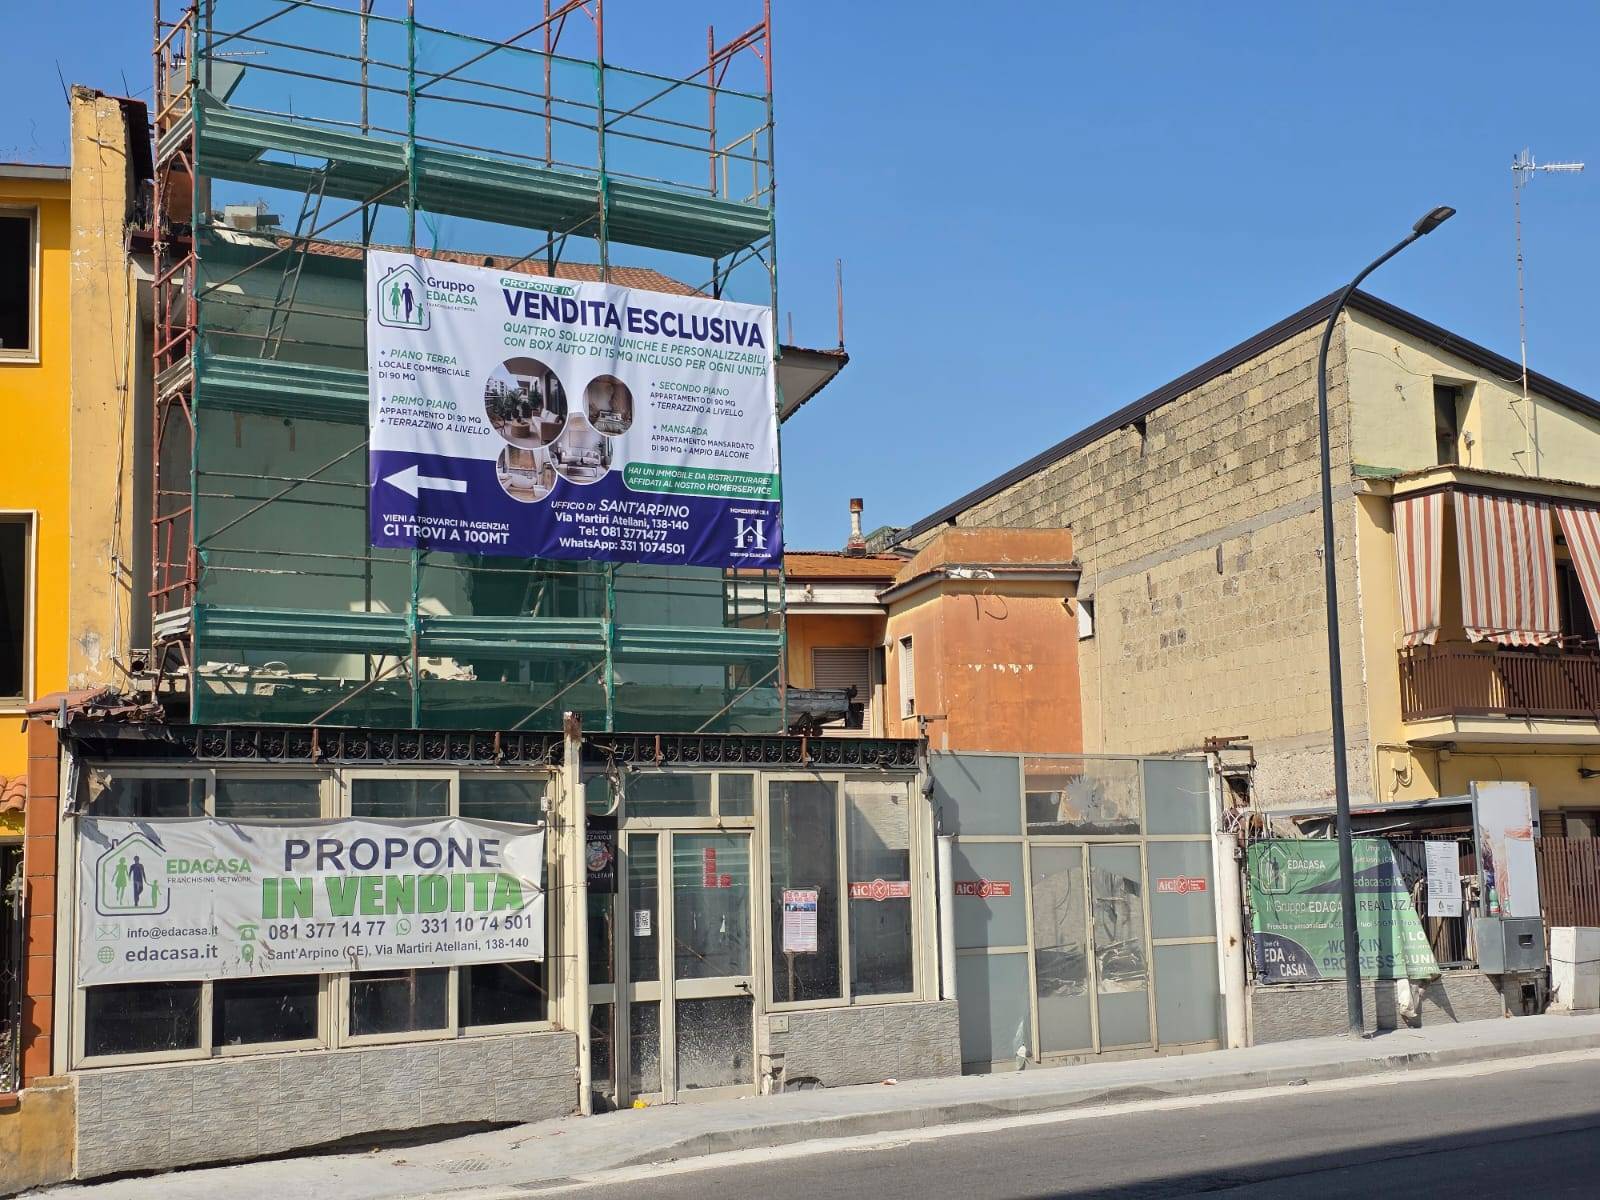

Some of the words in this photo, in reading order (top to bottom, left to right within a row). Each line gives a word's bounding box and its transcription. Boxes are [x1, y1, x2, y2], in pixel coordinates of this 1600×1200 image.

[427, 277, 475, 293] Gruppo
[502, 279, 559, 293] PROPONE
[560, 287, 573, 296] IN
[427, 291, 478, 306] EDACASA
[503, 289, 622, 330] VENDITA
[627, 306, 765, 348] ESCLUSIVA
[503, 322, 555, 338] QUATTRO
[559, 330, 617, 345] SOLUZIONI
[619, 338, 657, 352] UNICHE
[661, 344, 667, 353] E
[671, 345, 765, 364] PERSONALIZZABILI
[390, 349, 422, 361] PIANO
[427, 353, 457, 365] TERRA
[504, 336, 525, 348] CON
[530, 339, 552, 351] BOX
[556, 343, 586, 355] AUTO
[590, 348, 601, 357] DI
[605, 348, 614, 358] 15
[617, 351, 632, 362] MQ
[636, 353, 682, 367] INCLUSO
[686, 359, 705, 370] PER
[709, 362, 734, 374] OGNI
[379, 361, 411, 370] LOCALE
[414, 363, 470, 378] COMMERCIALE
[379, 371, 388, 379] DI
[390, 372, 400, 380] 90
[402, 373, 416, 381] MQ
[659, 381, 702, 394] SECONDO
[704, 385, 730, 396] PIANO
[391, 396, 425, 408] PRIMO
[427, 399, 457, 411] PIANO
[650, 392, 705, 404] APPARTAMENTO
[725, 399, 736, 407] MQ
[380, 407, 445, 420] APPARTAMENTO
[448, 413, 455, 422] DI
[456, 415, 467, 423] 90
[469, 416, 482, 424] MQ
[657, 402, 704, 413] TERRAZZINO
[713, 407, 743, 417] LIVELLO
[388, 417, 443, 431] TERRAZZINO
[446, 423, 454, 432] A
[455, 424, 490, 436] LIVELLO
[661, 423, 708, 436] MANSARDA
[652, 435, 706, 446] APPARTAMENTO
[708, 439, 755, 450] MANSARDATO
[671, 446, 682, 454] MQ
[689, 447, 712, 456] AMPIO
[715, 450, 749, 460] BALCONE
[628, 466, 641, 475] HAI
[643, 468, 654, 476] UN
[656, 469, 694, 479] IMMOBILE
[695, 472, 705, 480] DA
[629, 477, 661, 487] AFFIDATI
[674, 481, 705, 490] NOSTRO
[707, 483, 772, 495] HOMERSERVICE
[551, 500, 585, 510] UFFICIO
[587, 503, 595, 511] DI
[599, 499, 689, 518] SANT'ARPINO
[383, 513, 406, 523] VIENI
[409, 515, 415, 523] A
[417, 516, 458, 527] TROVARCI
[460, 520, 468, 528] IN
[470, 521, 509, 531] AGENZIA!
[555, 512, 573, 522] Via
[575, 513, 609, 525] Martiri
[612, 515, 649, 530] Atellani,
[652, 518, 689, 531] 138-140
[384, 523, 399, 536] CI
[403, 524, 446, 539] TROVI
[450, 528, 460, 541] A
[464, 529, 510, 544] 100MT
[579, 526, 598, 537] Tel:
[601, 526, 621, 539] 081
[623, 528, 667, 541] 3771477
[559, 537, 618, 552] WhatsApp:
[620, 540, 637, 552] 331
[639, 541, 685, 555] 1074501
[284, 837, 502, 872] PROPONE
[166, 858, 253, 874] EDACASA
[1287, 859, 1326, 871] EDACASA
[167, 876, 215, 884] FRANCHISING
[218, 875, 252, 883] NETWORK
[1158, 882, 1174, 892] AiC
[262, 876, 313, 919] IN
[325, 873, 525, 916] VENDITA
[850, 885, 869, 896] AiC
[956, 884, 974, 896] AiC
[1275, 900, 1306, 916] Gruppo
[127, 926, 218, 940] info@edacasa.it
[269, 923, 298, 941] 081
[306, 922, 336, 940] 377
[342, 921, 361, 939] 14
[367, 920, 386, 938] 77
[421, 918, 448, 935] 331
[456, 917, 474, 933] 10
[480, 916, 499, 932] 74
[505, 915, 532, 931] 501
[125, 945, 218, 962] edacasa.it
[267, 945, 339, 963] Sant'Arpino
[375, 943, 393, 956] Via
[397, 942, 432, 955] Martiri
[435, 939, 481, 954] Atellani,
[486, 937, 529, 950] 138-140
[1328, 939, 1366, 953] WOK
[1370, 938, 1383, 952] IN
[1264, 948, 1285, 963] EDA
[1323, 955, 1395, 972] PRORESS
[1279, 963, 1307, 977] CASA!
